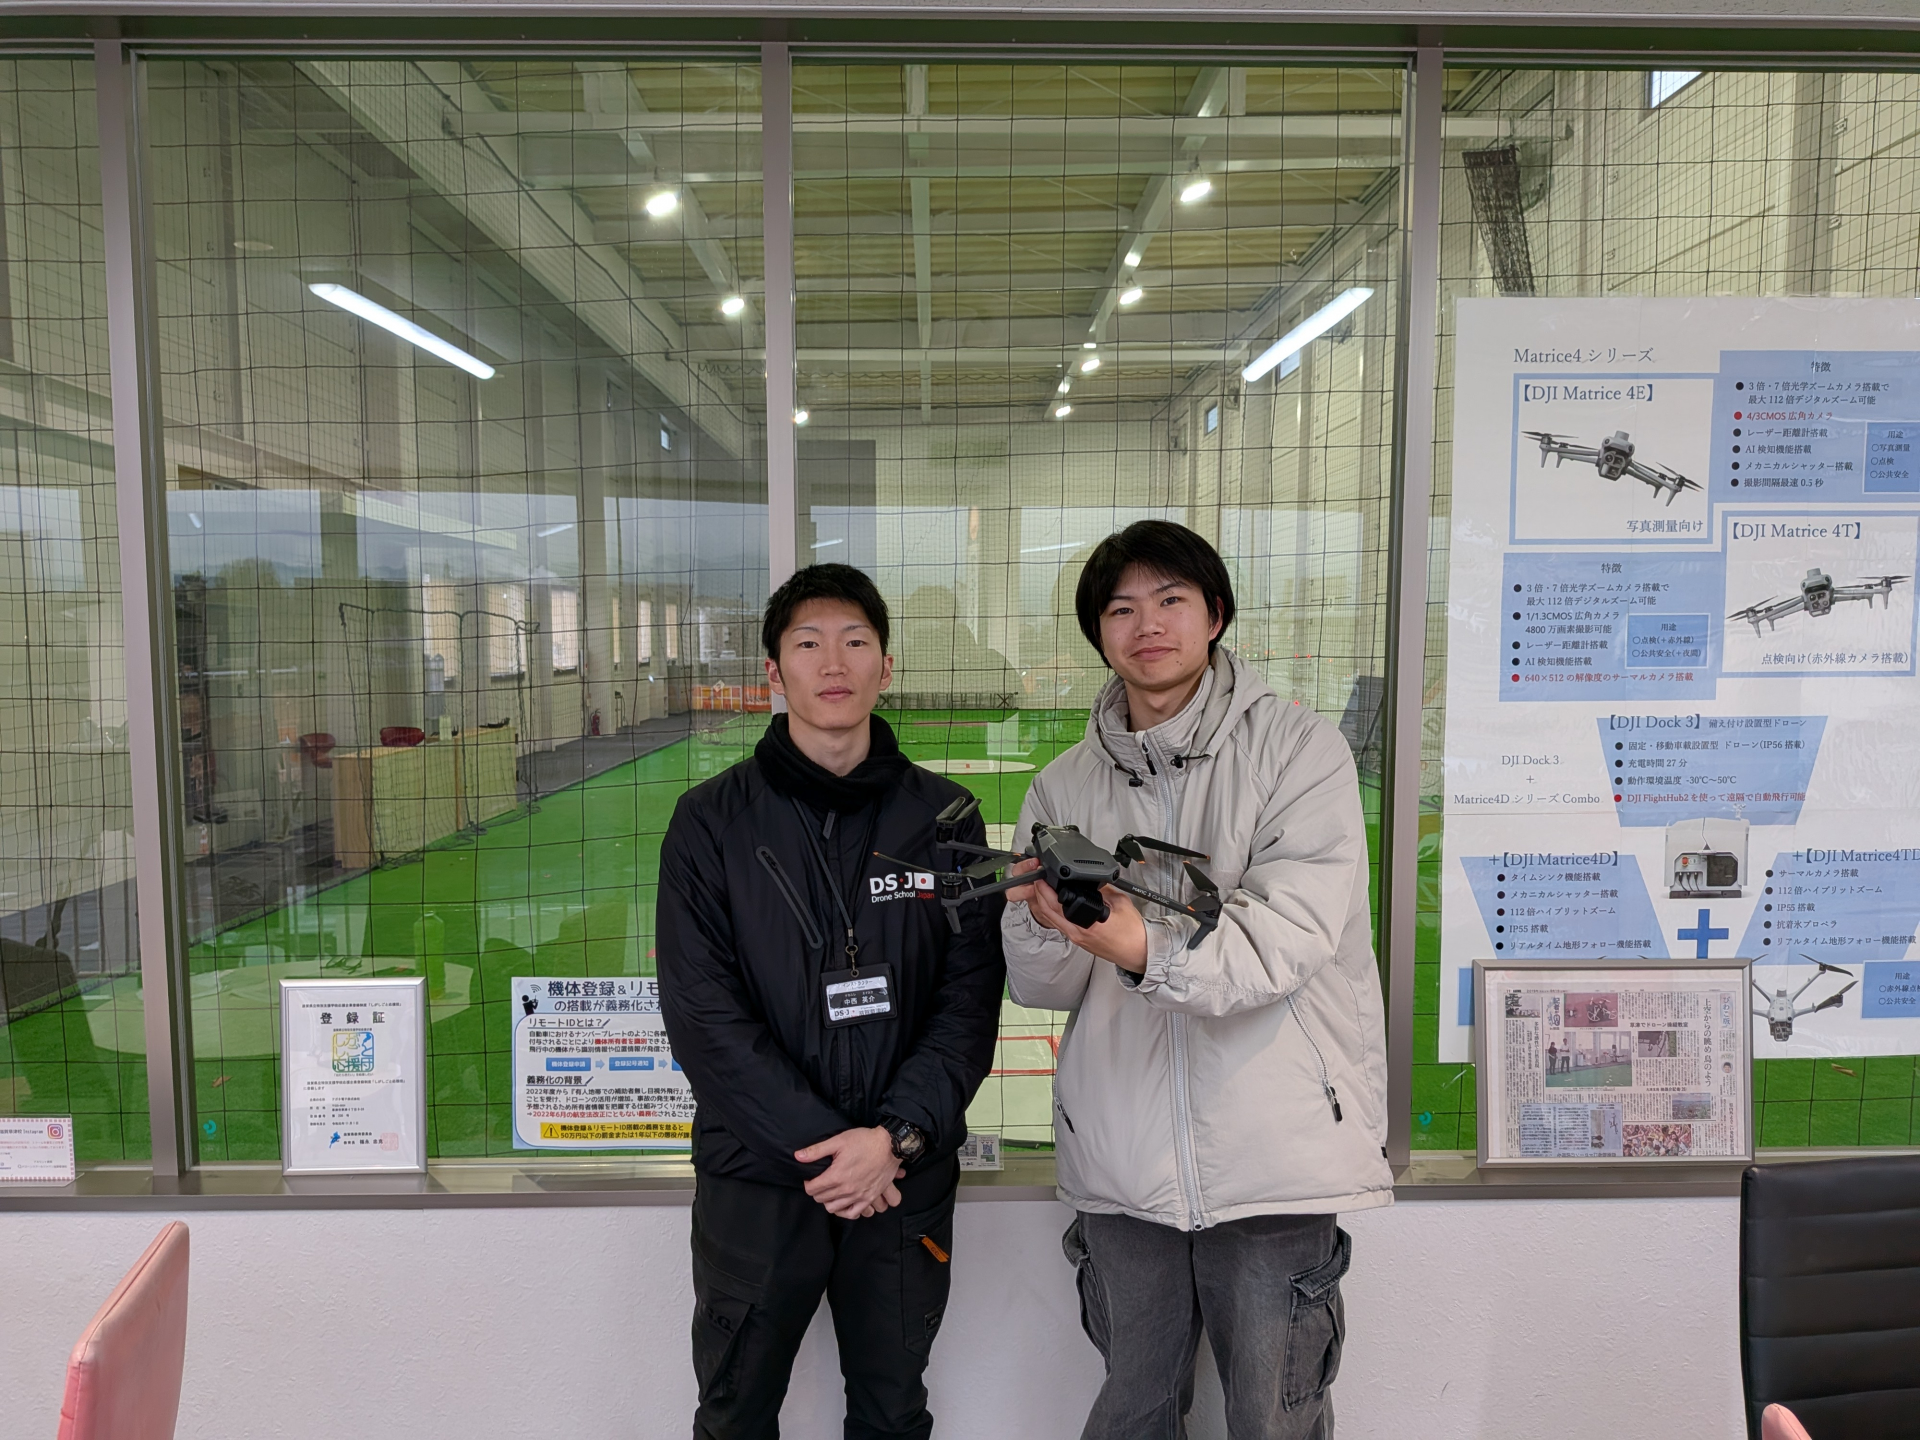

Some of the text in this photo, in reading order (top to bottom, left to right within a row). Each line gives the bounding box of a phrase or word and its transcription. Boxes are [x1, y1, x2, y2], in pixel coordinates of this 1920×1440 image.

[1514, 348, 1654, 363] Matrice4 シリーズ
[1811, 361, 1831, 373] 特徴
[1563, 385, 1621, 400] Matrice
[1747, 428, 1828, 438] レーザー距離計搭載
[1887, 431, 1904, 439] 用途
[1745, 461, 1854, 471] メカニカルシャッター搭載
[1626, 519, 1704, 533] 写真測量向け
[1770, 523, 1827, 538] Matrice
[1601, 563, 1622, 574] 特徴
[1660, 623, 1677, 632] 用途
[1526, 640, 1608, 650] レーザー距離計搭載
[1761, 652, 1909, 665] 点検向け(赤外線カメラ搭載)
[1645, 715, 1682, 729] Dock
[1708, 719, 1807, 729] 備え付け設置型ドローン
[1501, 754, 1560, 767] DJI Dock 3
[1627, 776, 1682, 786] 動作環境温度
[1454, 793, 1600, 804] Matrice4D シリーズ Combo
[1627, 794, 1642, 803] DJI
[1511, 872, 1601, 882] タイムシンク機能搭載
[1778, 868, 1859, 878] サーマルカメラ搭載
[871, 890, 935, 904] Drone School Japan
[1510, 889, 1619, 899] メカニカルシャッター搭載
[1510, 940, 1652, 950] リアルタイム地形フォロー機能搭載
[1777, 936, 1917, 946] リアルタイム地形フォロー機能搭載
[1894, 972, 1911, 980] 用途
[526, 1075, 583, 1085] 義務化の背景
